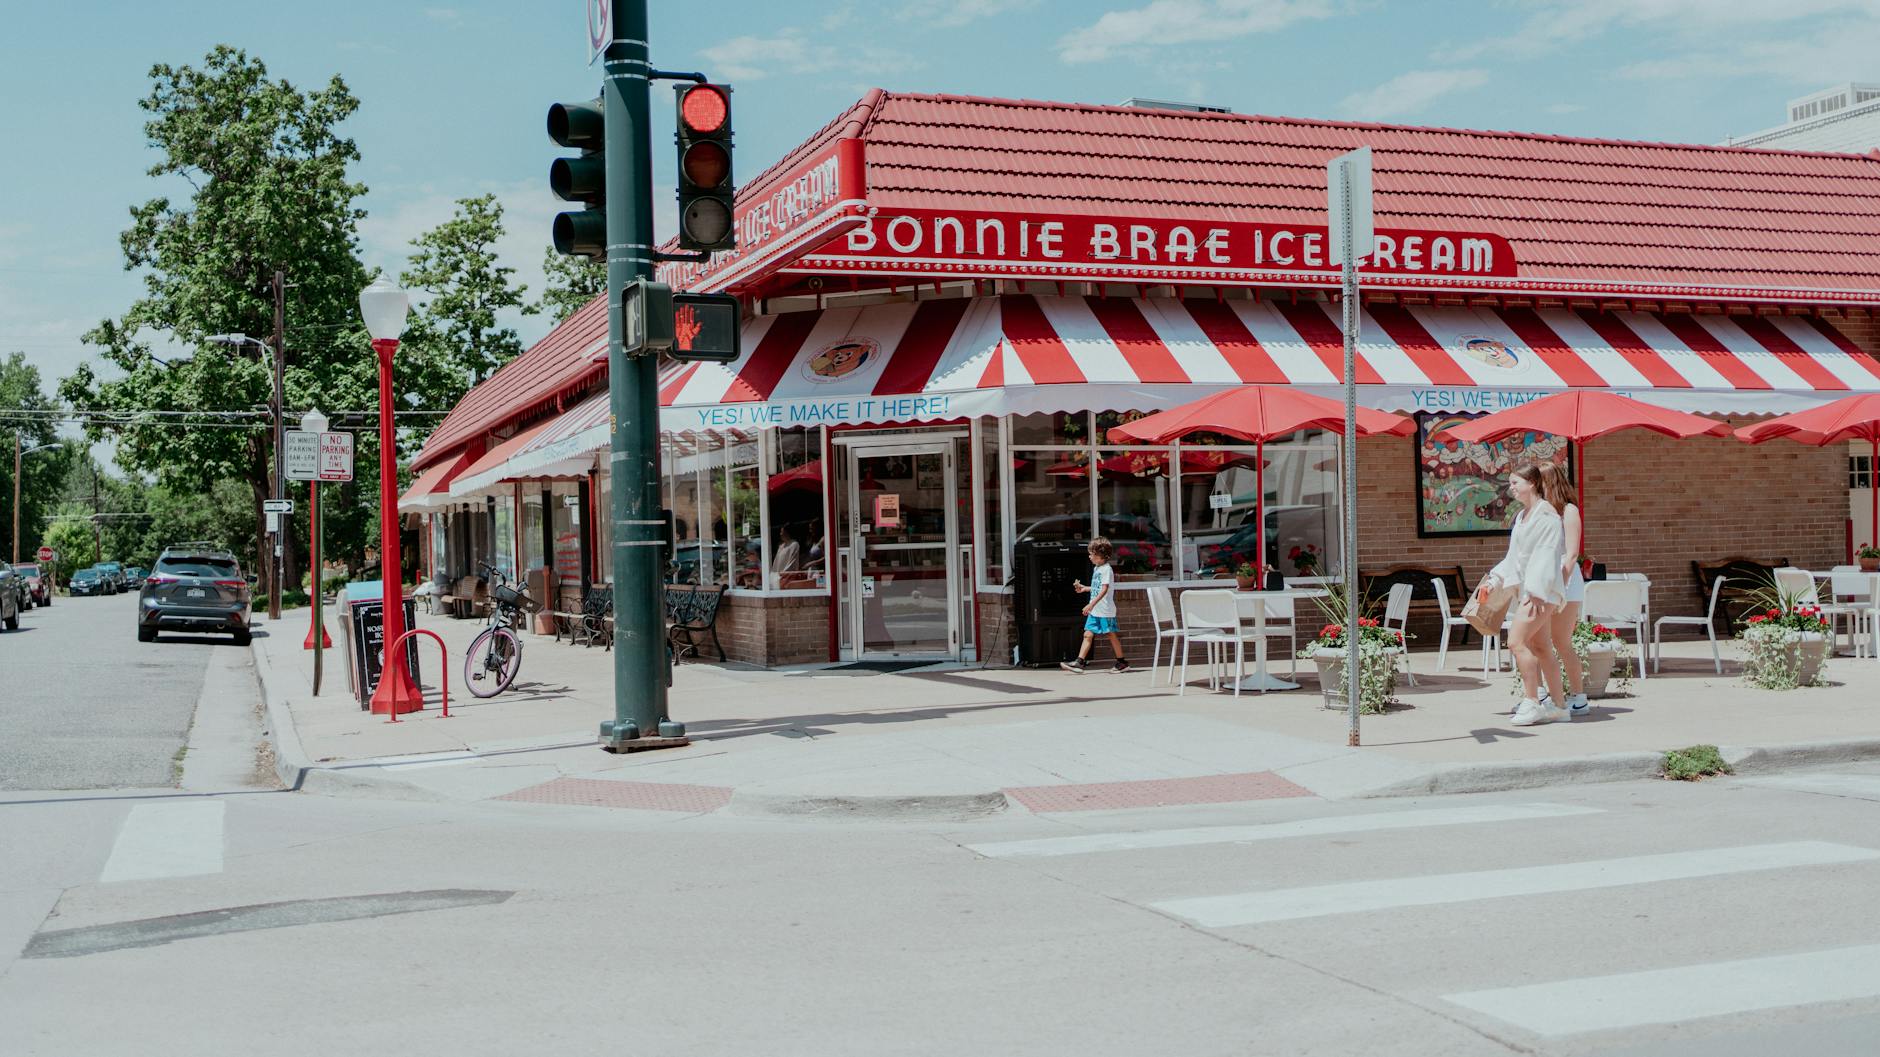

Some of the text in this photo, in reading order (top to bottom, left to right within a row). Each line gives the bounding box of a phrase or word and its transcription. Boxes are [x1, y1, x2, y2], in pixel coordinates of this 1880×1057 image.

[848, 215, 1493, 273] BONNIE BRAE ICE REAM
[1411, 390, 1456, 407] YES!
[1463, 391, 1493, 407] WE
[698, 396, 949, 426] YES! WE MAKE IT HERE!
[329, 436, 342, 444] NO
[321, 445, 350, 455] PARKING
[39, 550, 52, 558] STOP
